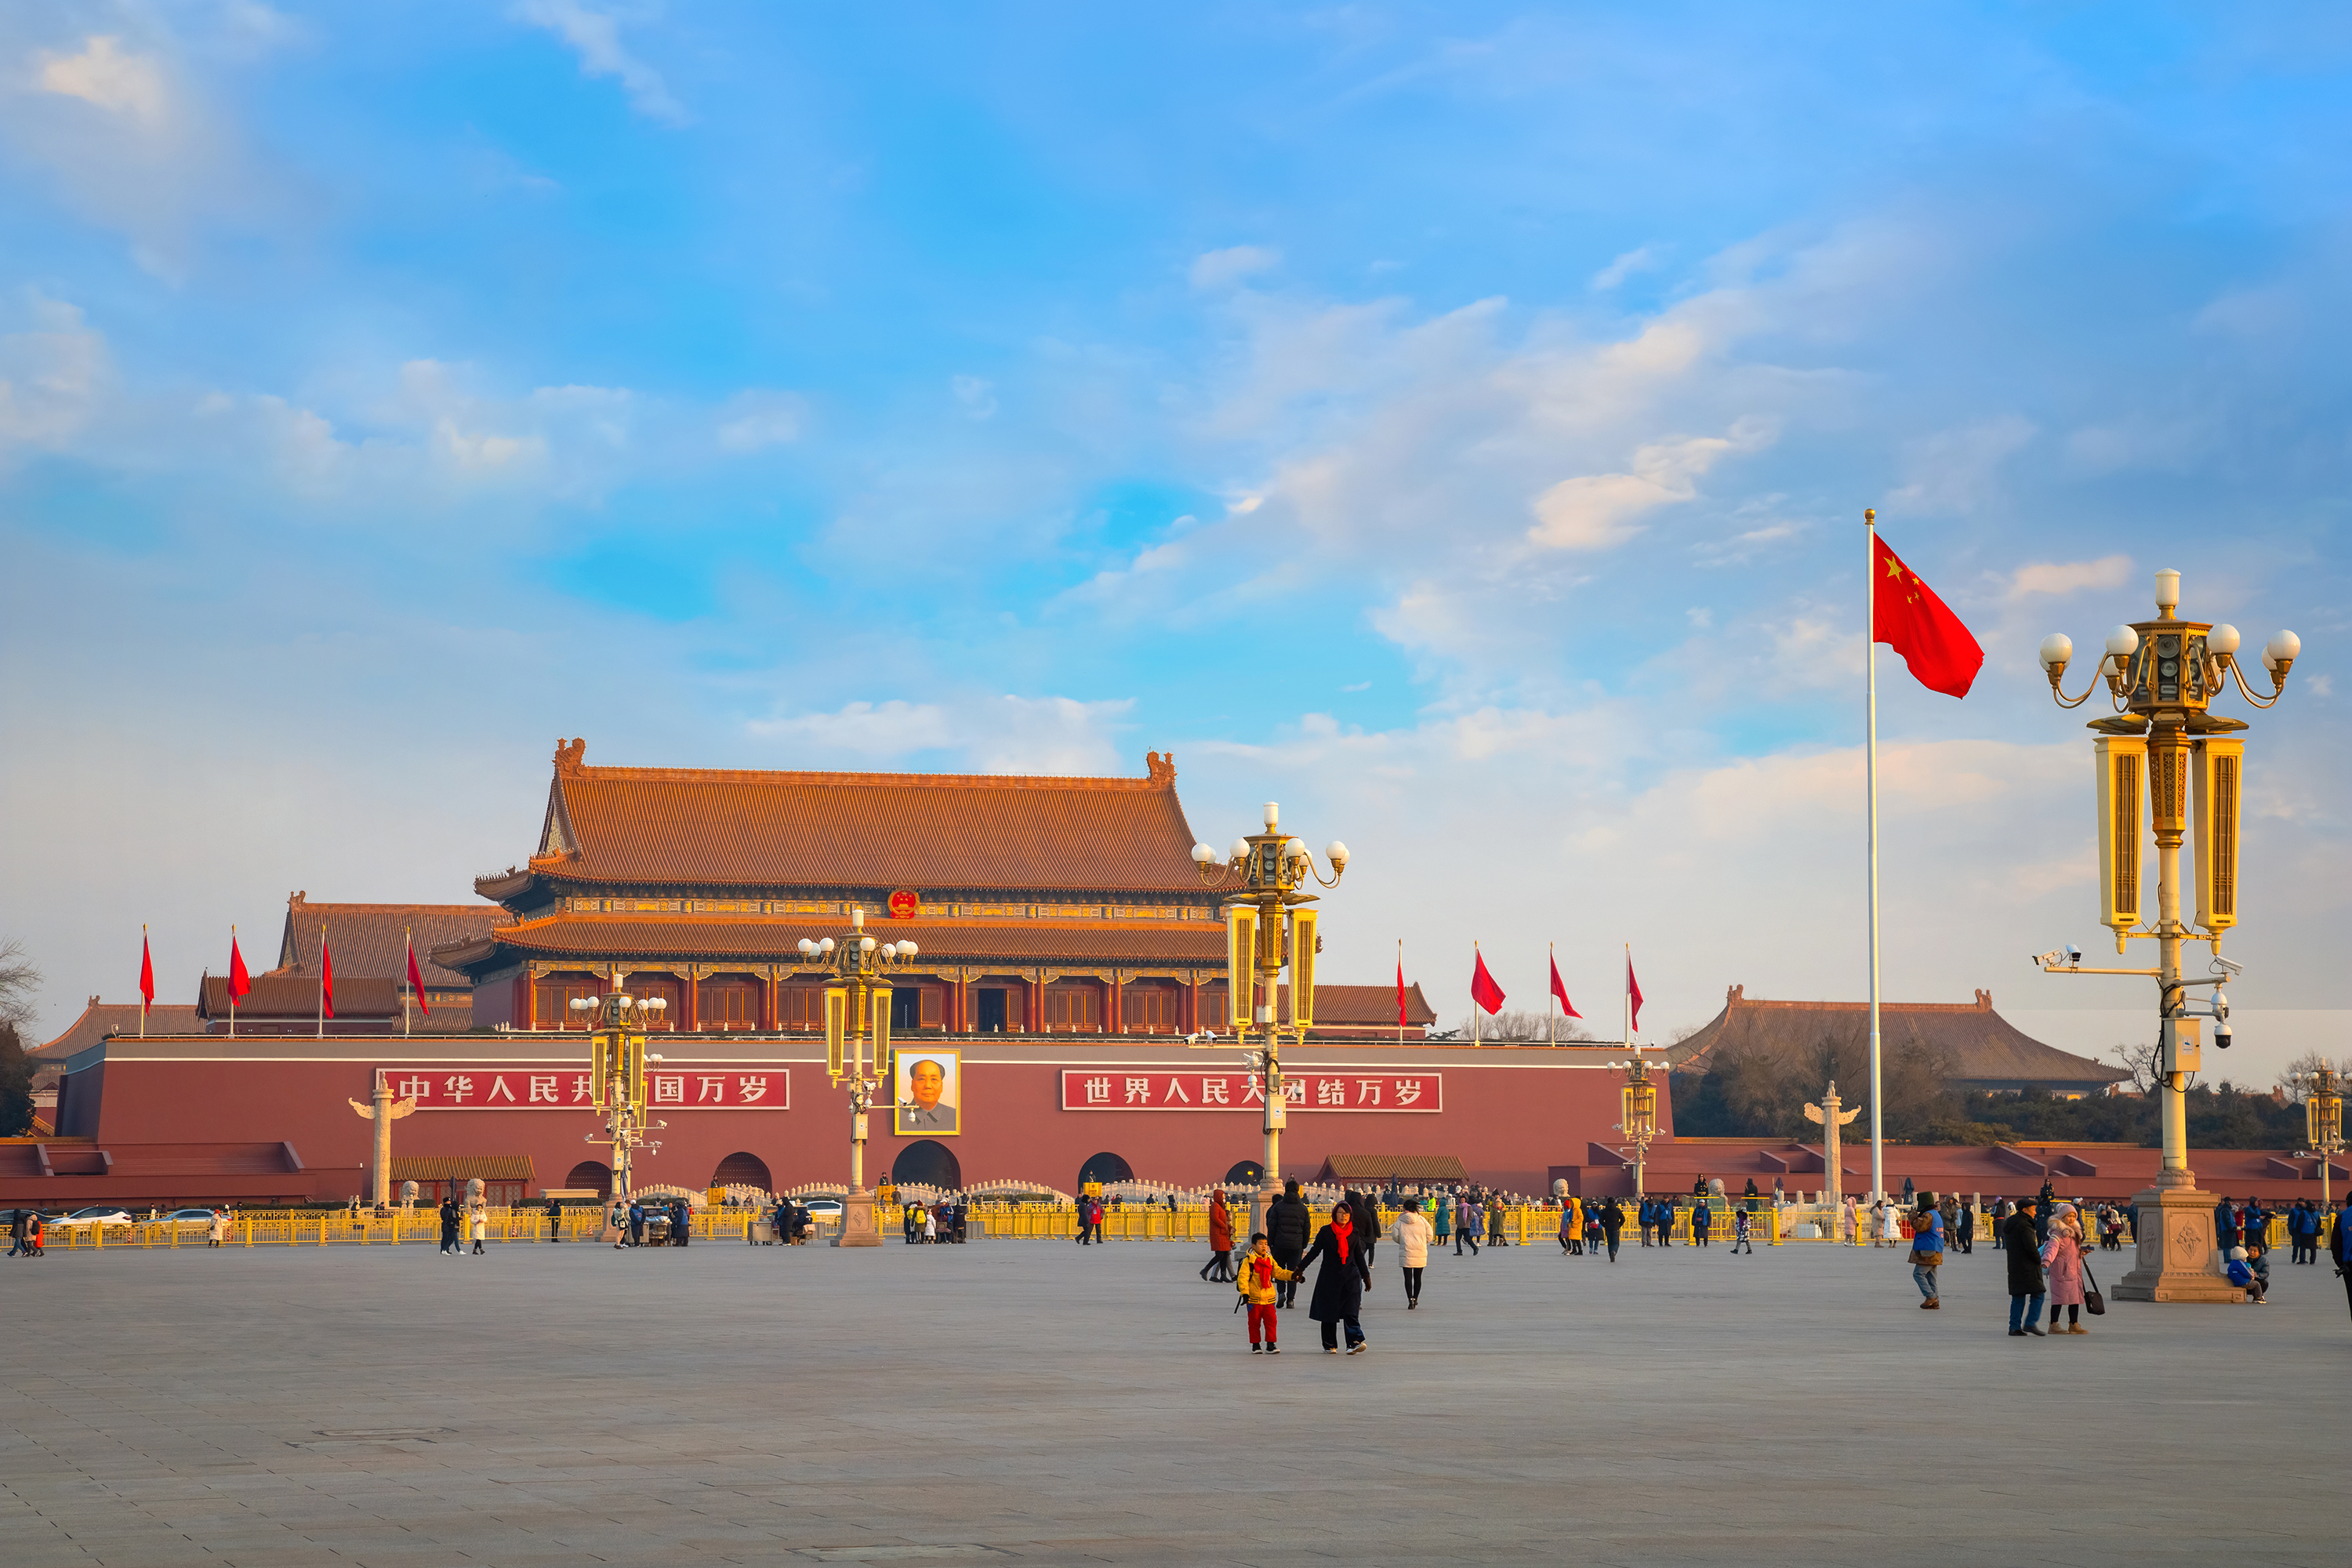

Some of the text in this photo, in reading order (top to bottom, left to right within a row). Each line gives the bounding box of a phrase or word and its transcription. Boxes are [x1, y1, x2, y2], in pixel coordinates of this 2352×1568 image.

[399, 1075, 768, 1103] 中华人民共国万岁
